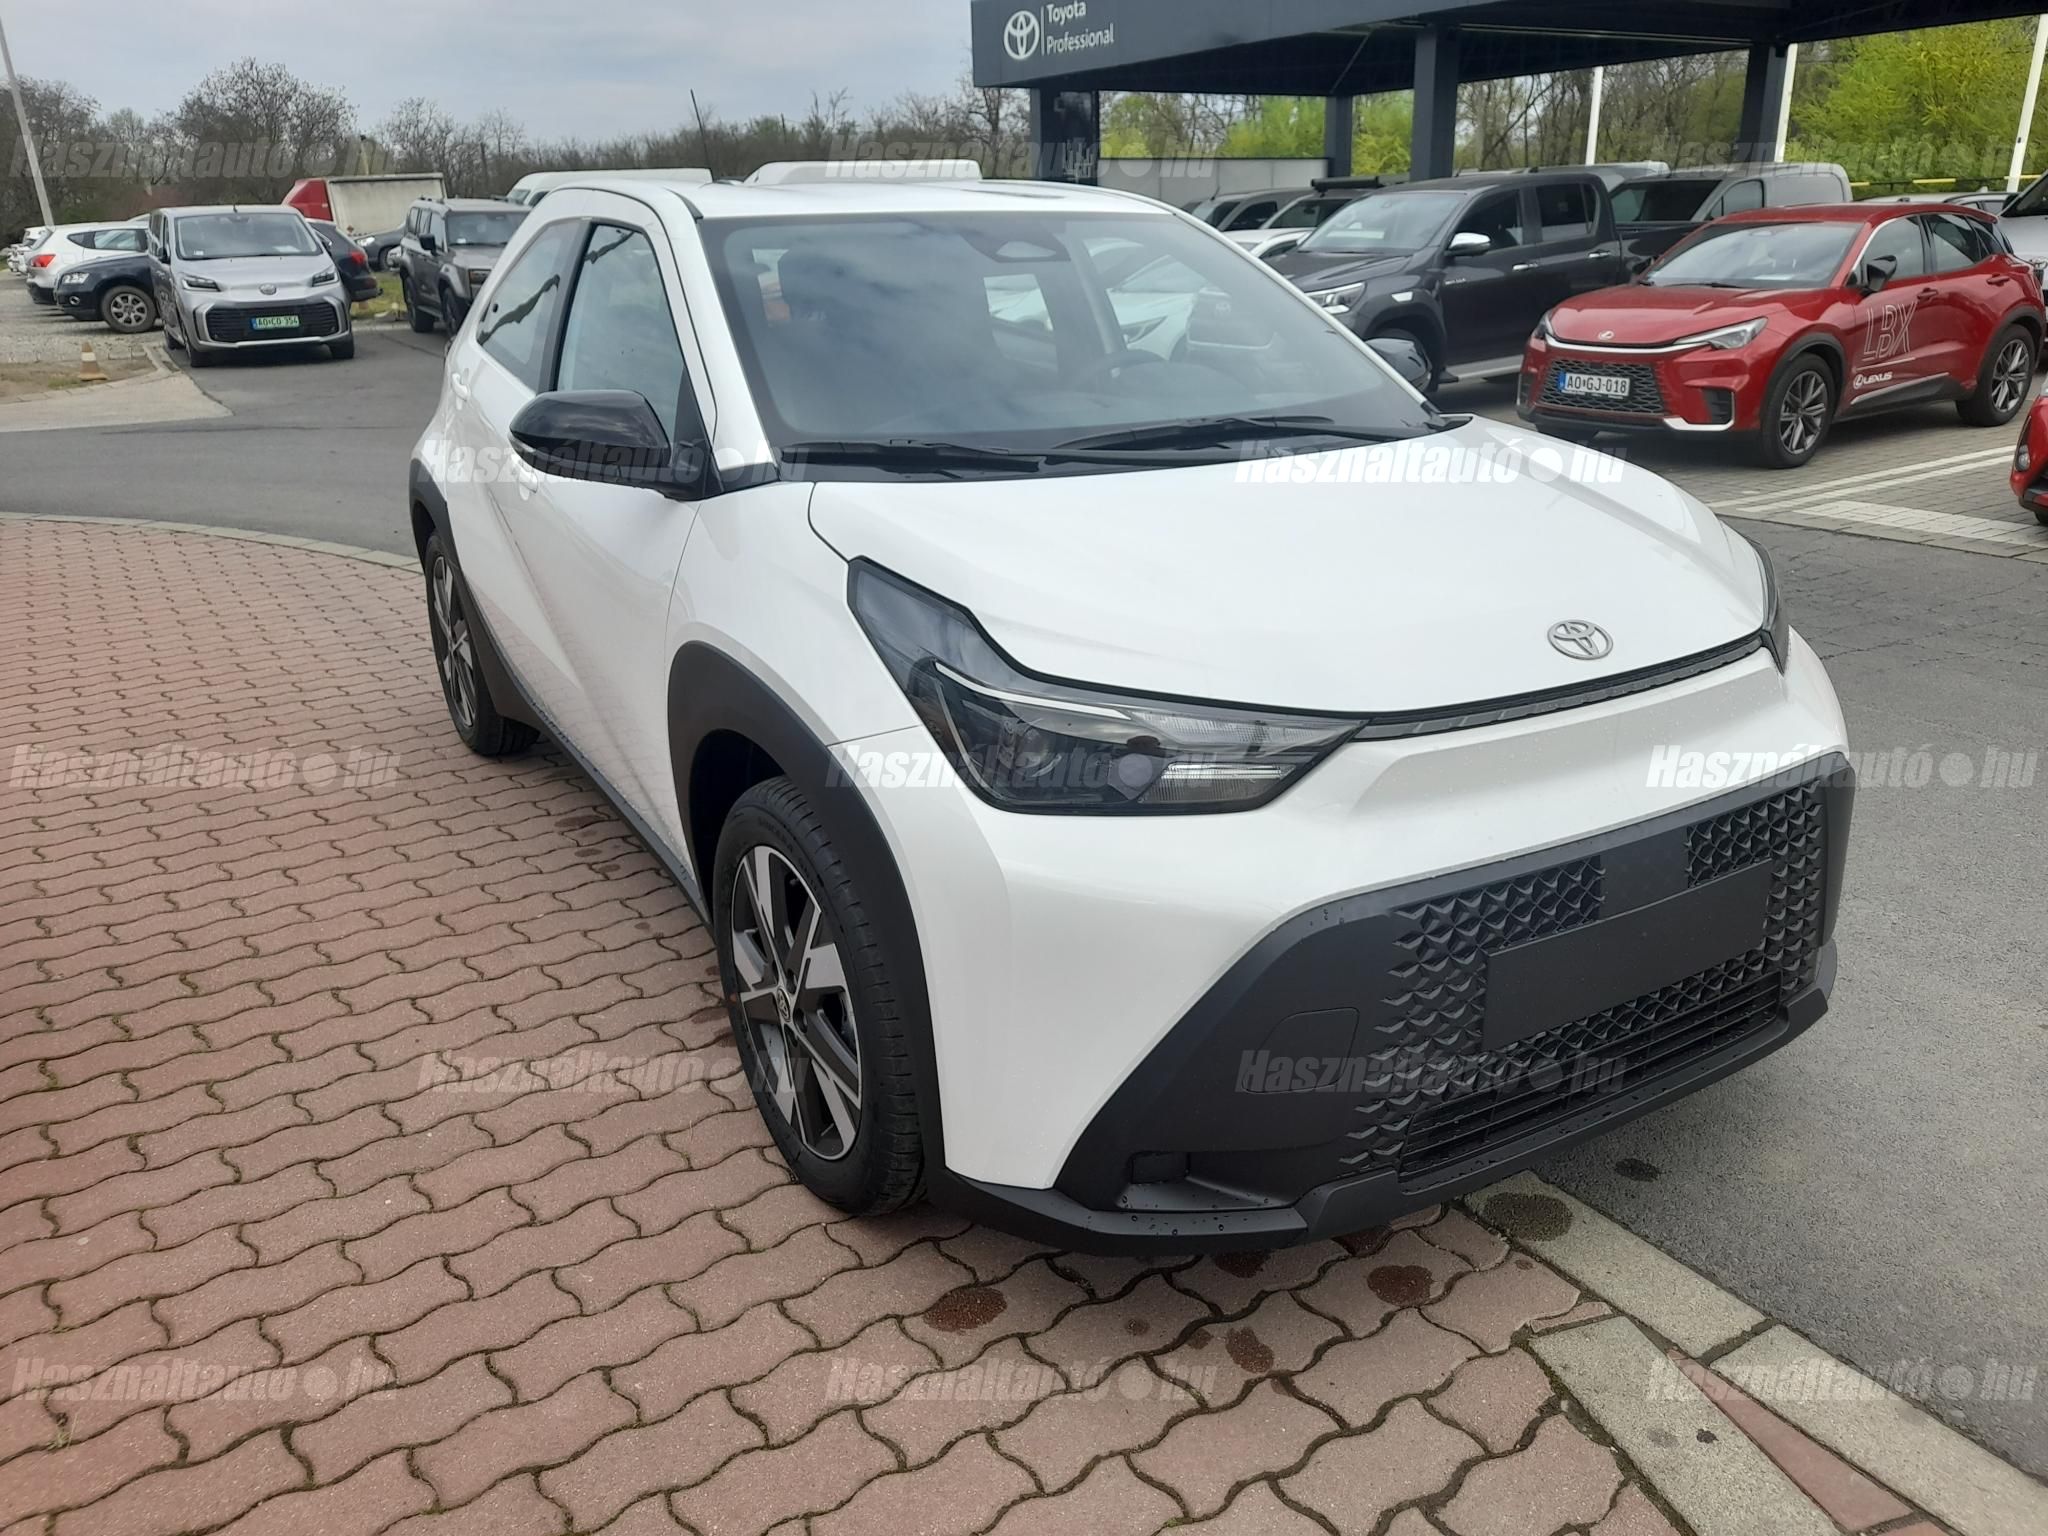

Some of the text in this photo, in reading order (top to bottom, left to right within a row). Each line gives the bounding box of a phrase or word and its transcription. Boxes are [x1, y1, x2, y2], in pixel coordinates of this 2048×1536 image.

[1046, 0, 1086, 25] Toyota
[1046, 23, 1114, 55] Professional
[1861, 301, 1918, 361] LBX
[1863, 371, 1893, 384] LEXUS
